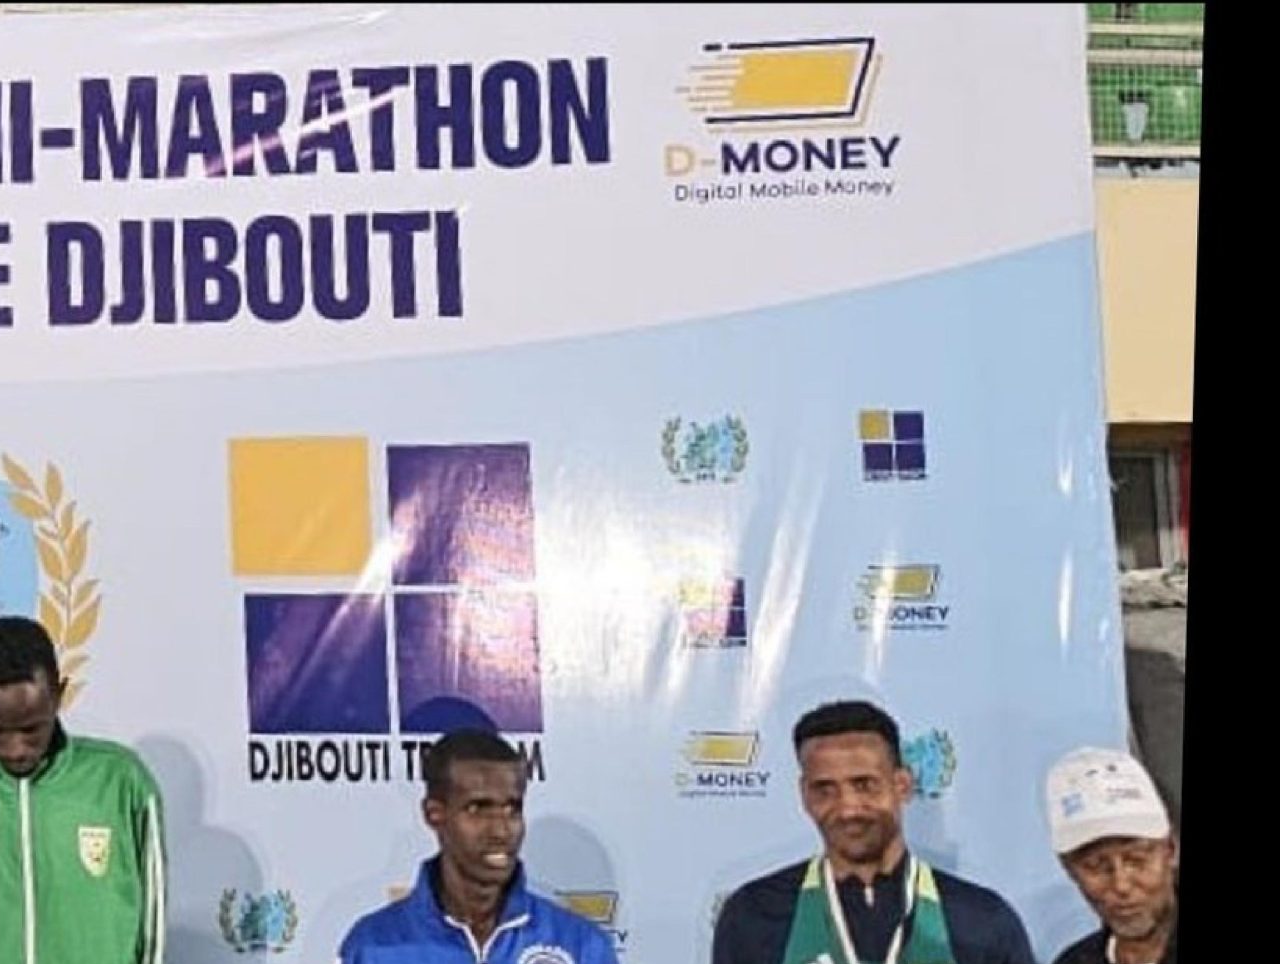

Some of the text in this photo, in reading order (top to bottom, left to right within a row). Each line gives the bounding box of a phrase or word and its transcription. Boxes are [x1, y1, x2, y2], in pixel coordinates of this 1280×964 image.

[664, 136, 900, 176] D-MONEY
[675, 176, 895, 204] Digital Mobile Money
[46, 211, 465, 327] DJIBOUTI
[247, 740, 391, 783] DJIBOUTI
